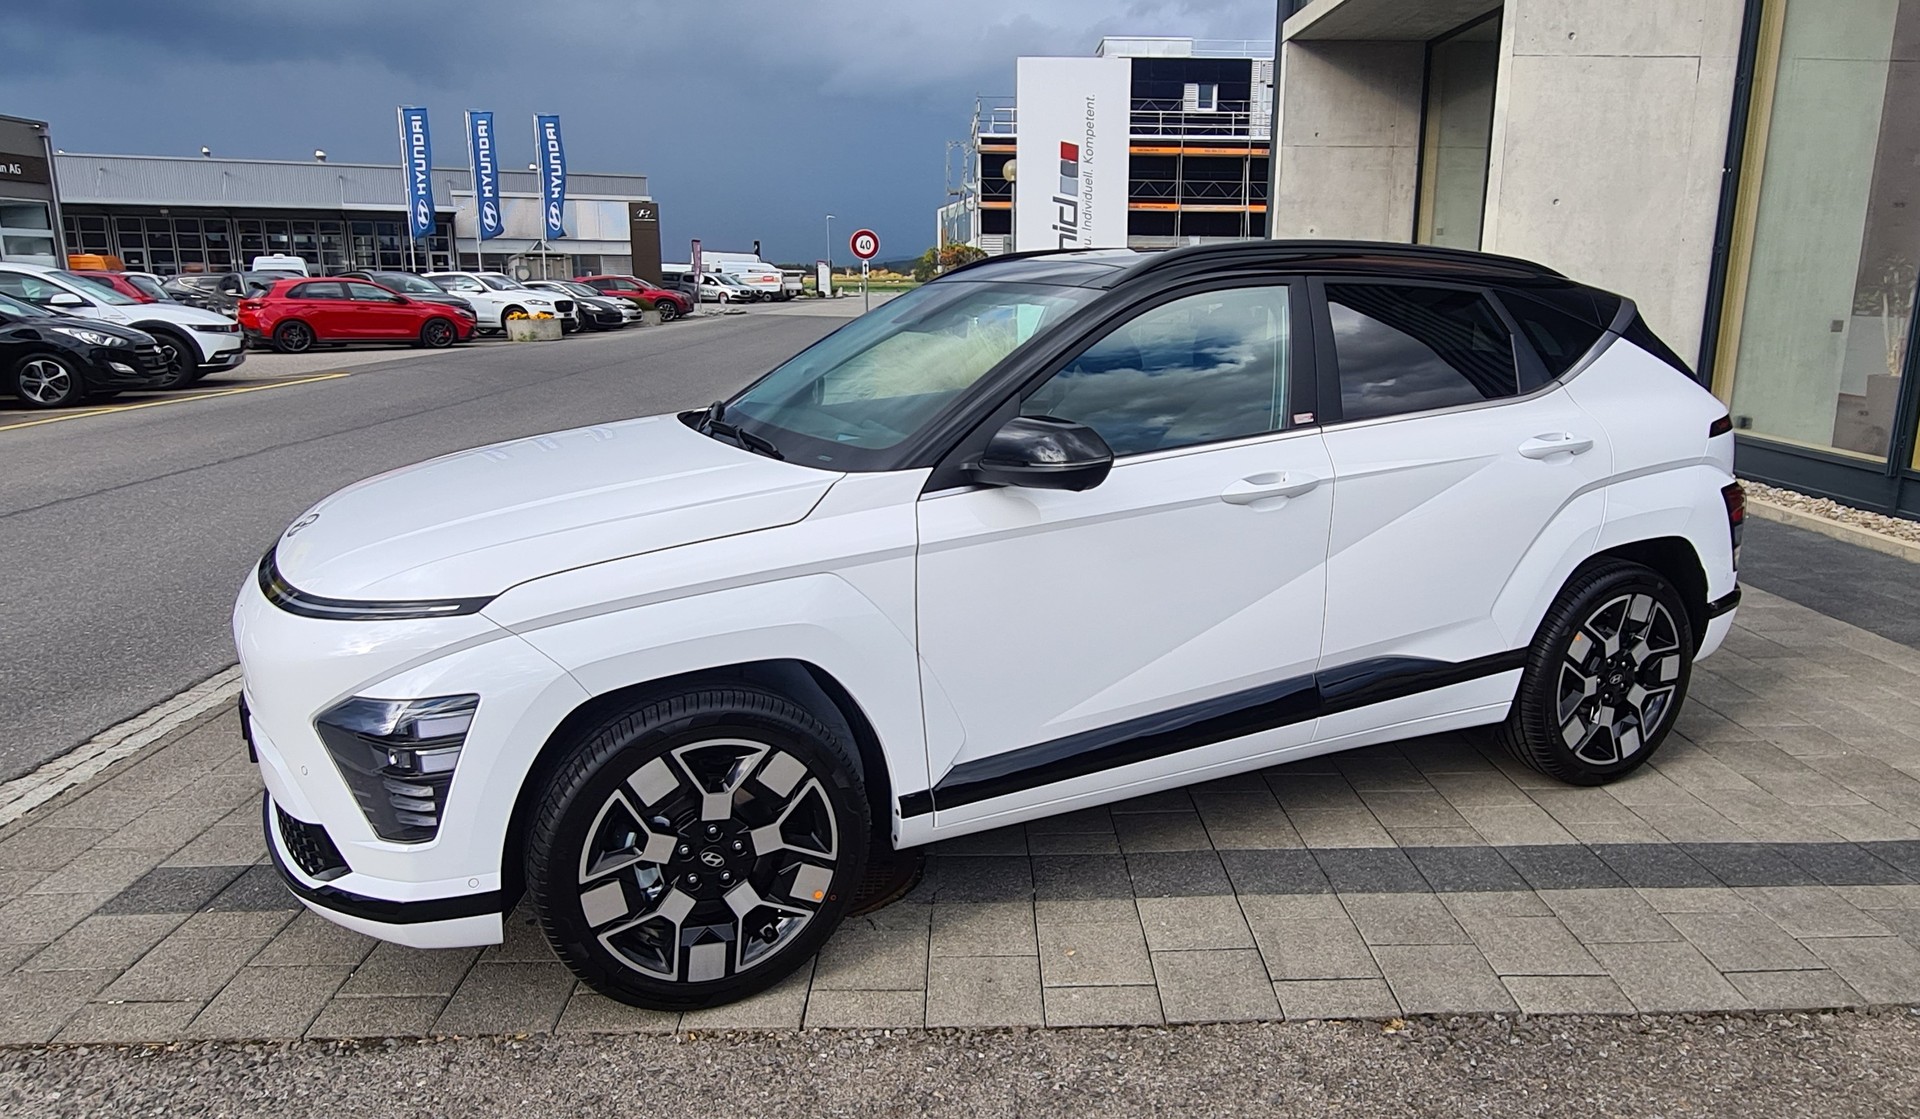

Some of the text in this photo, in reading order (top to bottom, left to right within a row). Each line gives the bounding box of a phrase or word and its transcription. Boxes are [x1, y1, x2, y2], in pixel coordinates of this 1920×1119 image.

[411, 115, 426, 195] HYUNDAI
[477, 119, 493, 198] HYUNDAI
[545, 122, 562, 198] HYUNDAI
[1083, 94, 1096, 165] Kompetent.
[9, 163, 22, 175] AG
[1081, 169, 1094, 231] Individuell.
[859, 239, 872, 250] 40
